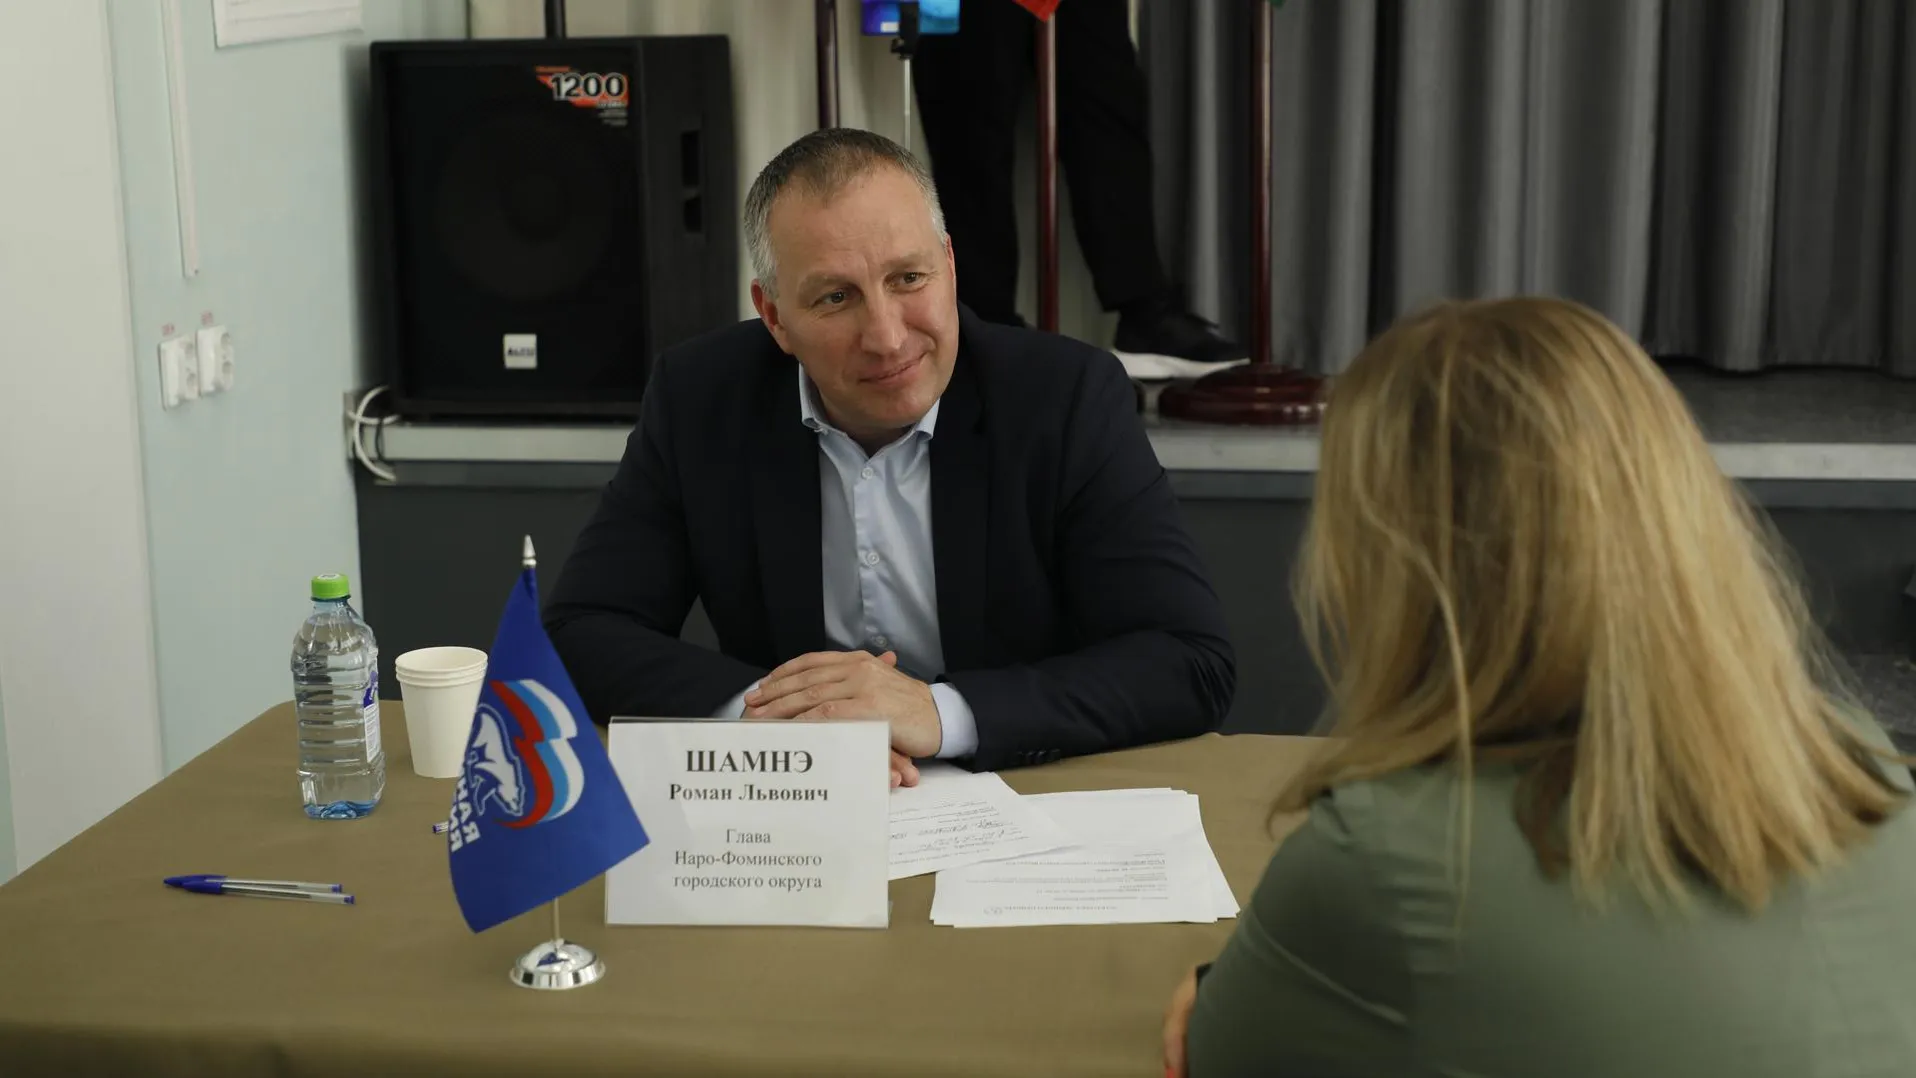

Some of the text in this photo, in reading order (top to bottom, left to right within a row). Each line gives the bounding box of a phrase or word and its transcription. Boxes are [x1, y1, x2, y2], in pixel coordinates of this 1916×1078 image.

[551, 73, 626, 100] 1200
[686, 750, 813, 773] ШАМНЭ
[669, 783, 828, 801] Роман Львович
[725, 829, 771, 844] Глава
[674, 850, 822, 868] Наро-Фоминского
[673, 875, 822, 893] городского округа
